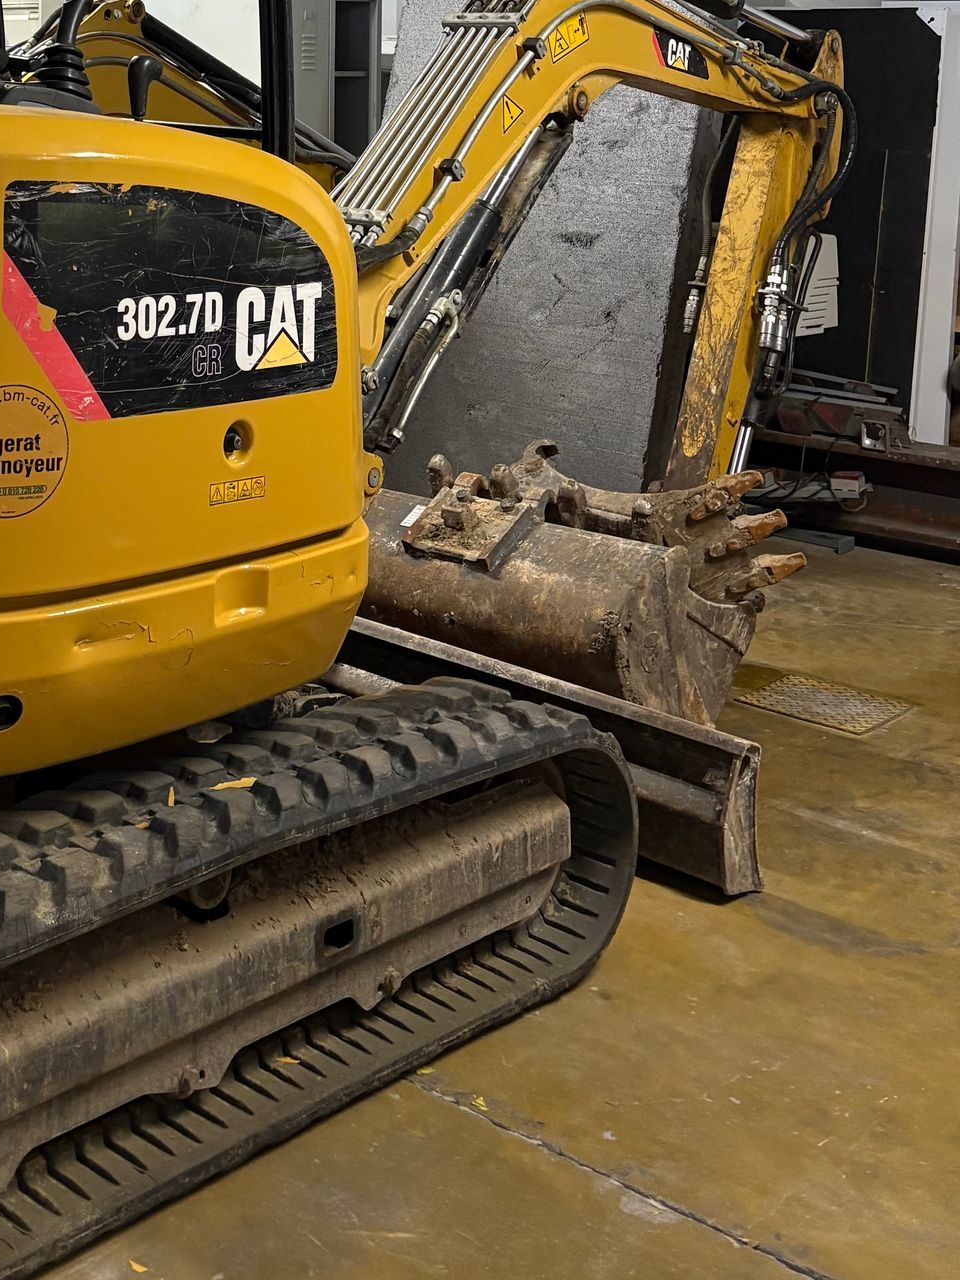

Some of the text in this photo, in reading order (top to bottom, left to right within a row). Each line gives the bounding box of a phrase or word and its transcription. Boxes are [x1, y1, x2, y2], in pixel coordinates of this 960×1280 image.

[667, 38, 691, 71] CAT
[117, 281, 323, 371] 302.7D CAT
[191, 343, 222, 377] CR
